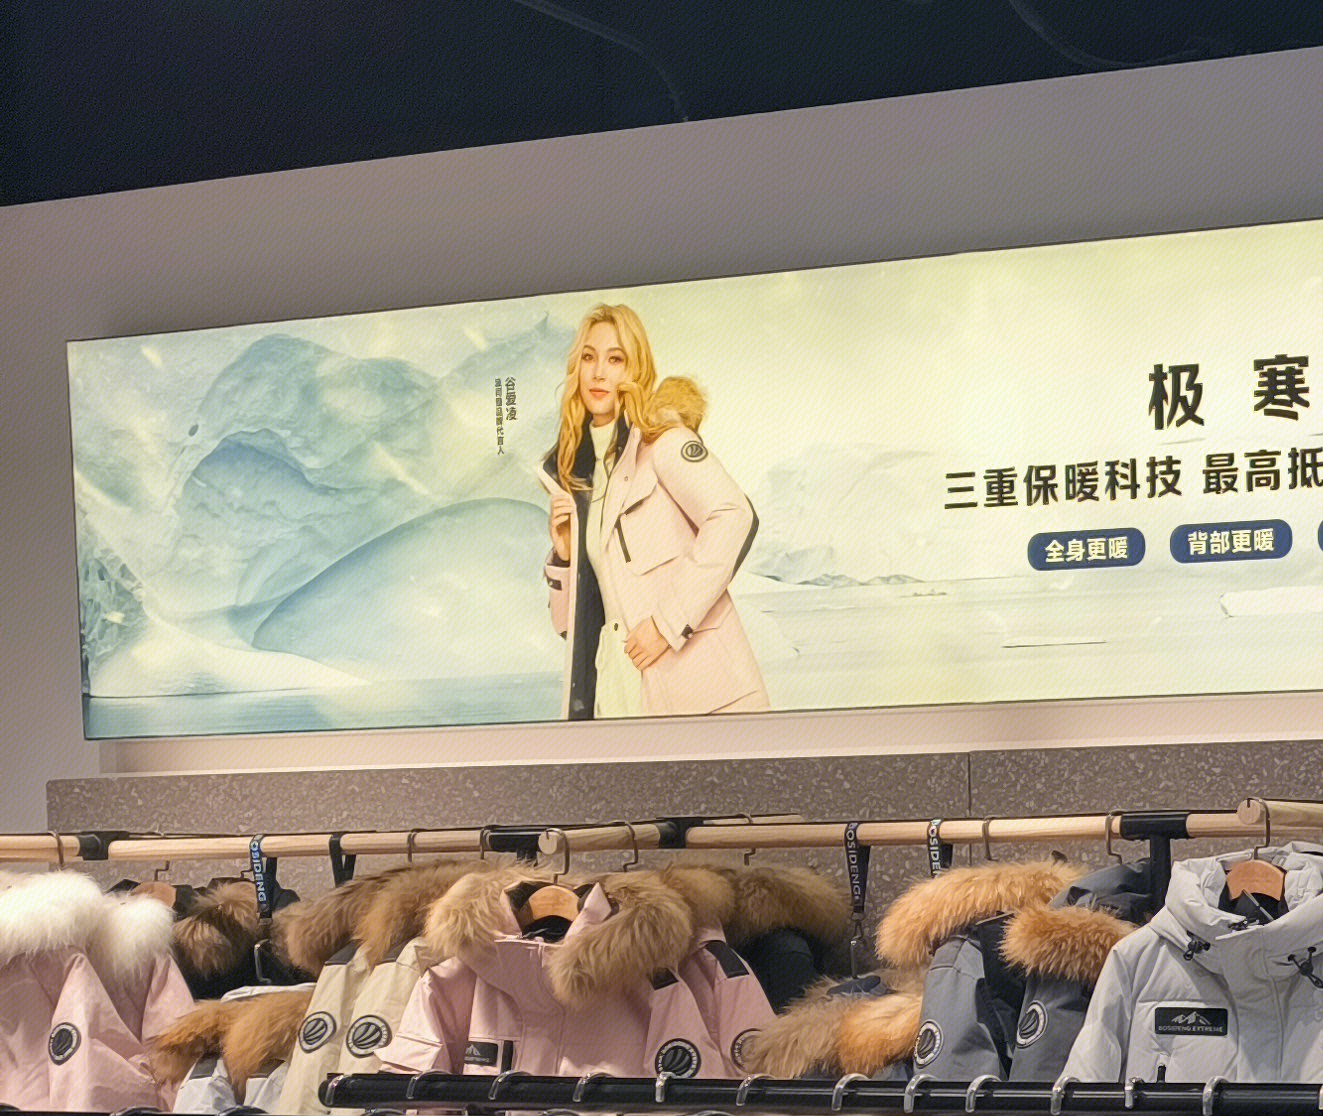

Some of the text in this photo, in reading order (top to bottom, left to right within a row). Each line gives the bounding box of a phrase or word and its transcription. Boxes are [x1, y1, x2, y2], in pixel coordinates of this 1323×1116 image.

[1148, 353, 1311, 430] 极寒
[943, 457, 1183, 509] 三重保暖科技
[1044, 537, 1129, 564] 全身更暖
[1186, 528, 1276, 556] 背部更暖
